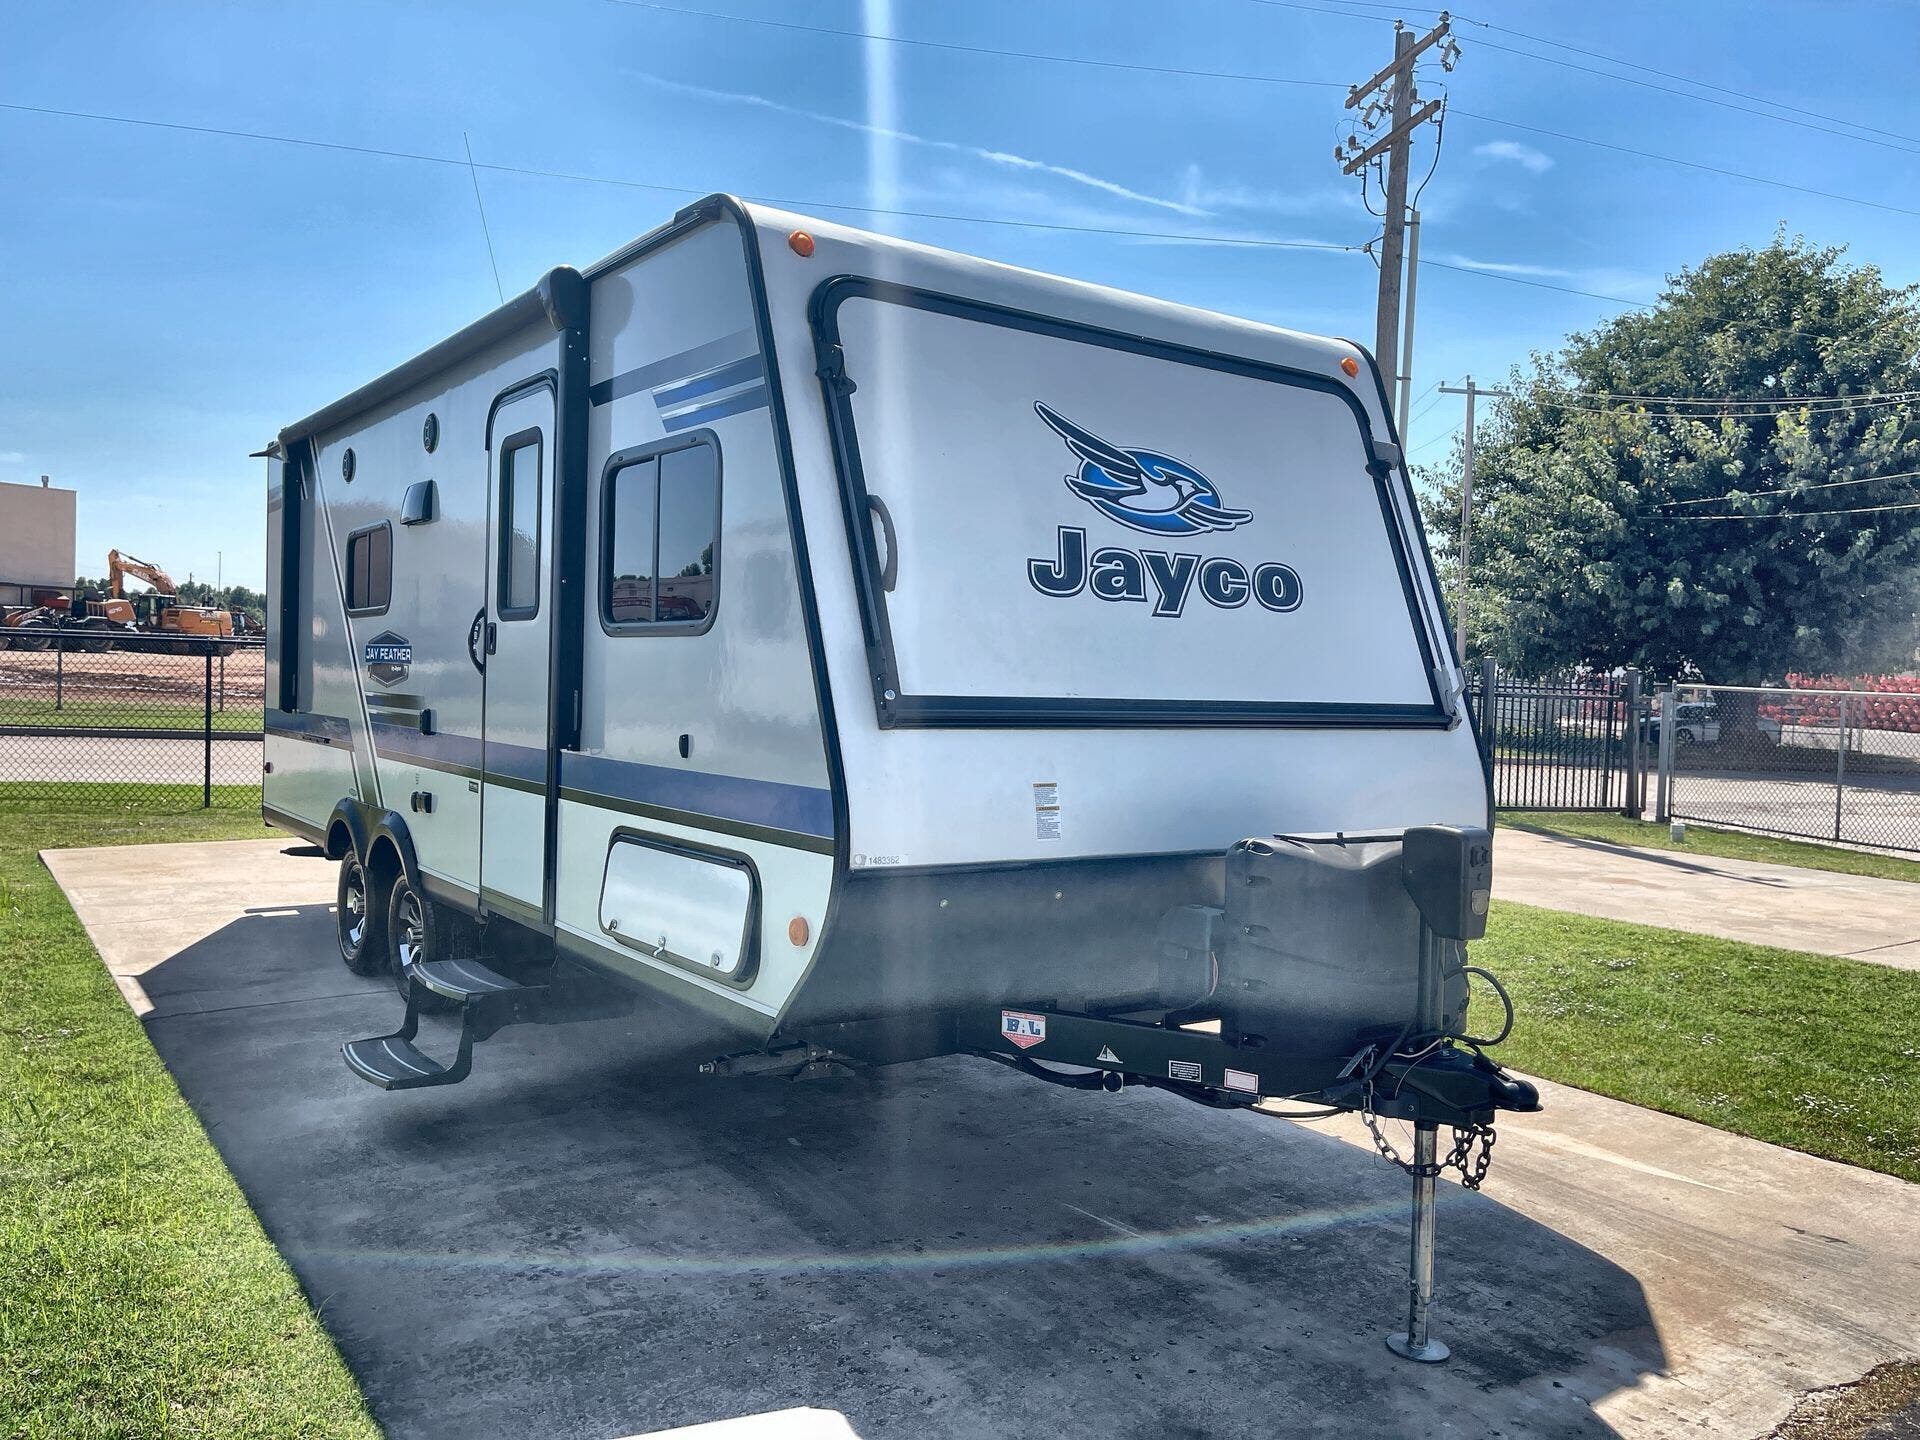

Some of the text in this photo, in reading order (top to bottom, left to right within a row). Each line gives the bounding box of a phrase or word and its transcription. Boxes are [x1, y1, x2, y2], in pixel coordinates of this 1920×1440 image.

[1026, 525, 1304, 619] Jayco
[366, 648, 411, 661] JAY FEATHER
[869, 855, 900, 865] 1483362
